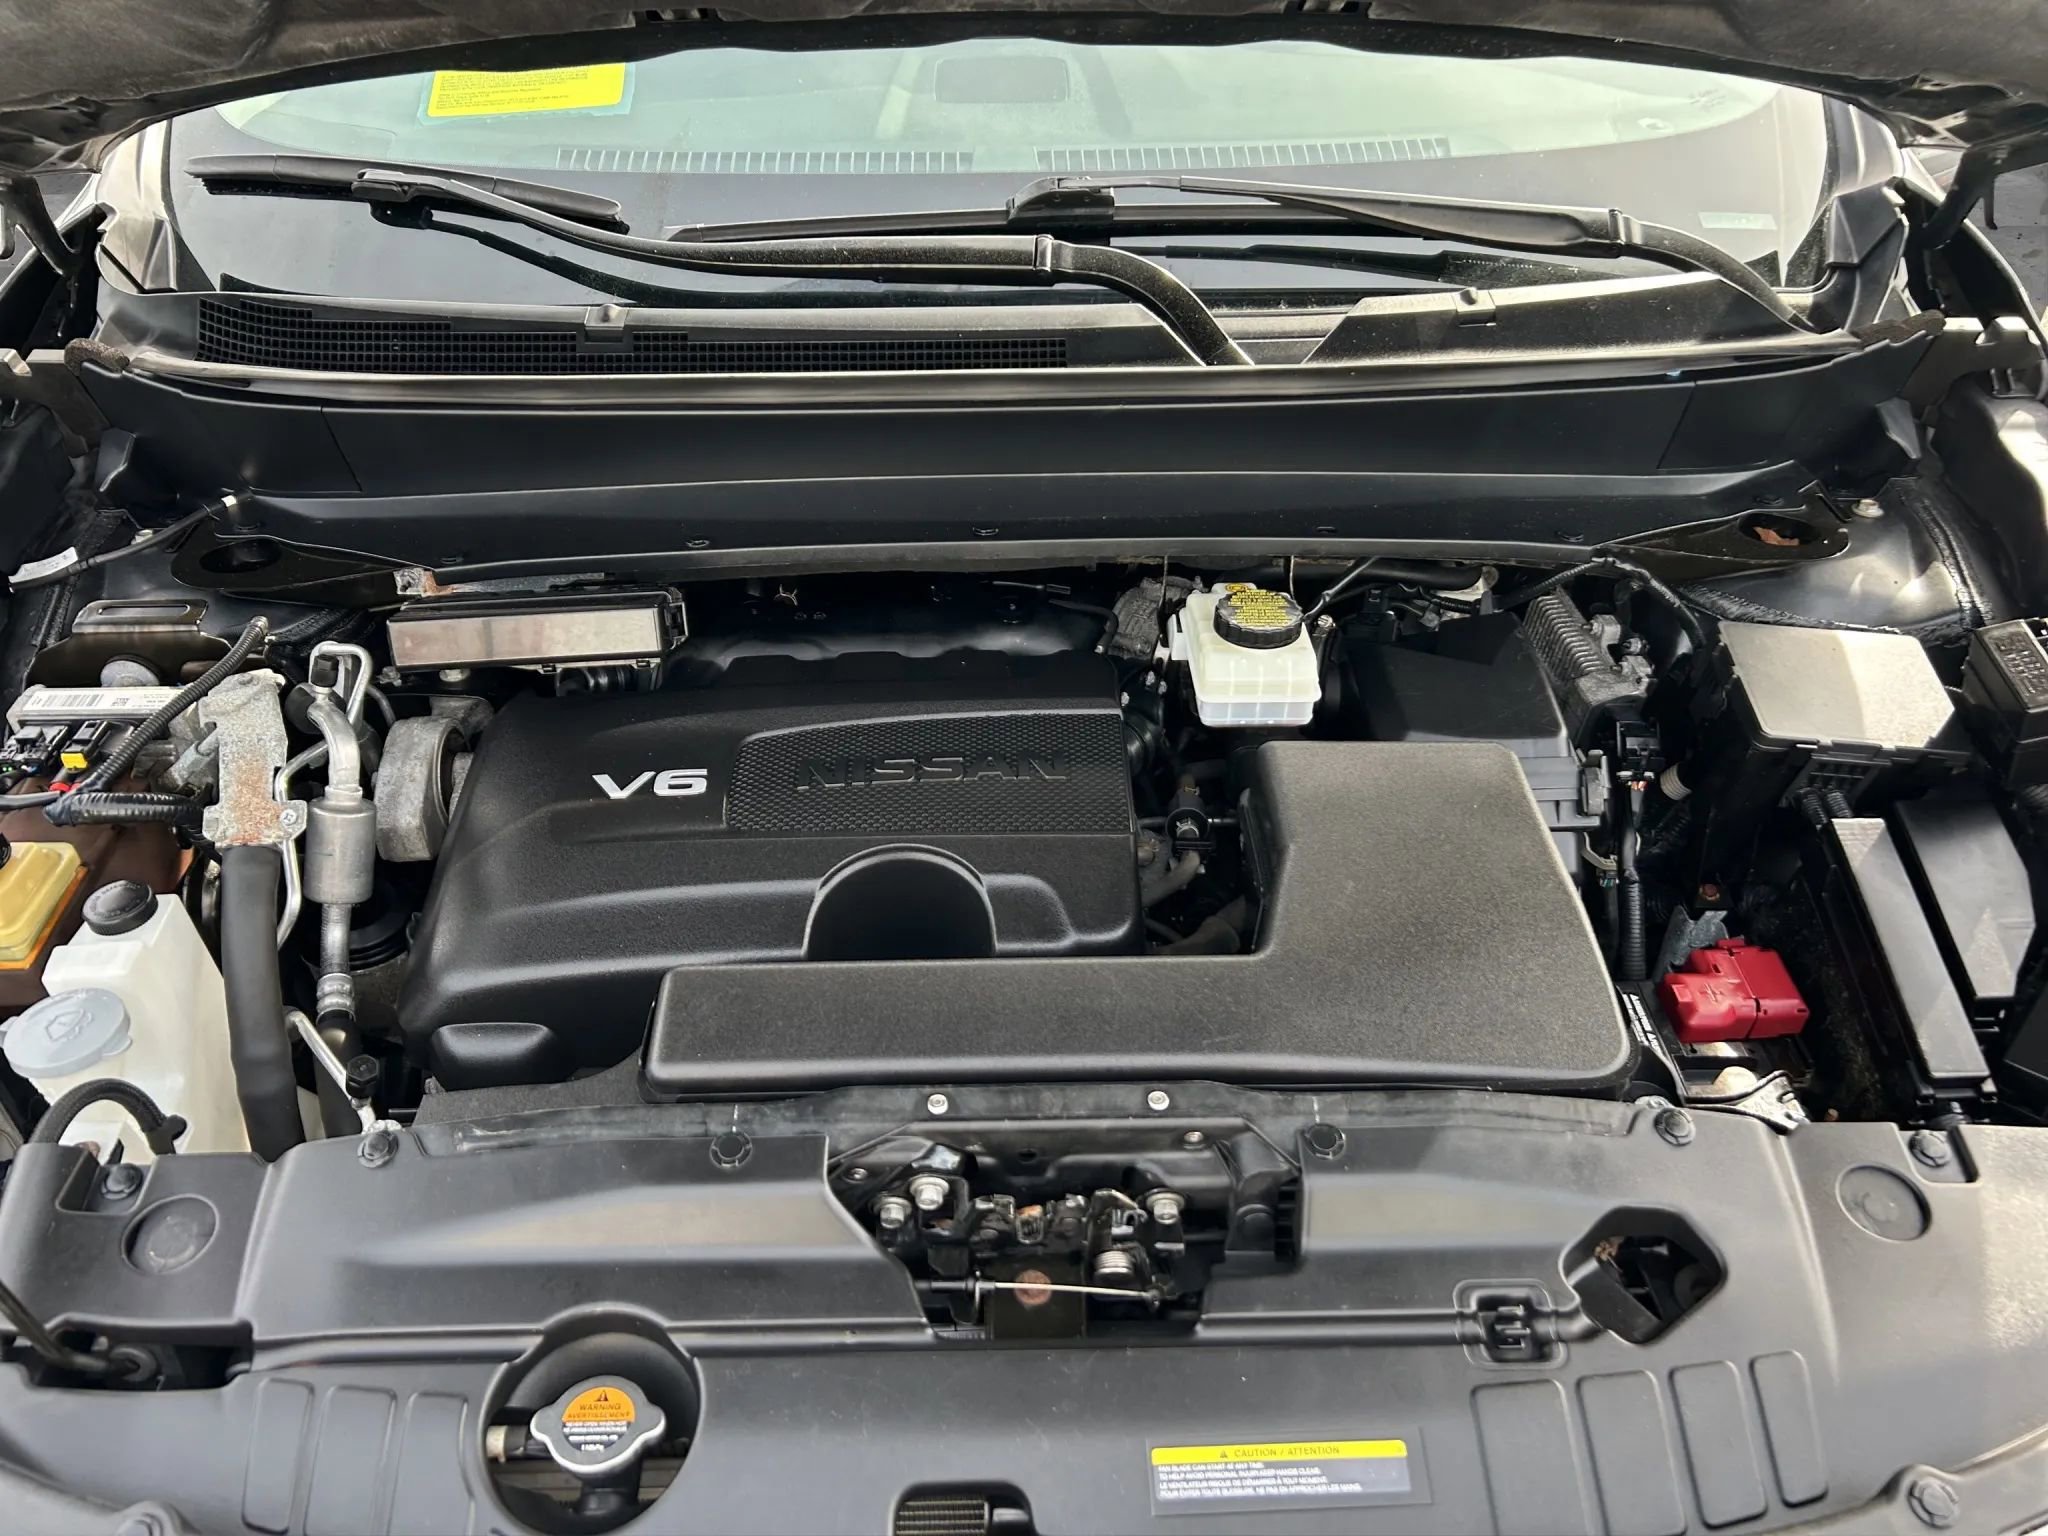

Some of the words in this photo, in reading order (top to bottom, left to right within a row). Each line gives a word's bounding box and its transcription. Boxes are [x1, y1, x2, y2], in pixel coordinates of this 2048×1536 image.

[592, 768, 708, 799] V6
[797, 755, 1067, 789] NISSAN
[1234, 1448, 1277, 1457] CAUTION
[1287, 1446, 1340, 1455] ATTENTION
